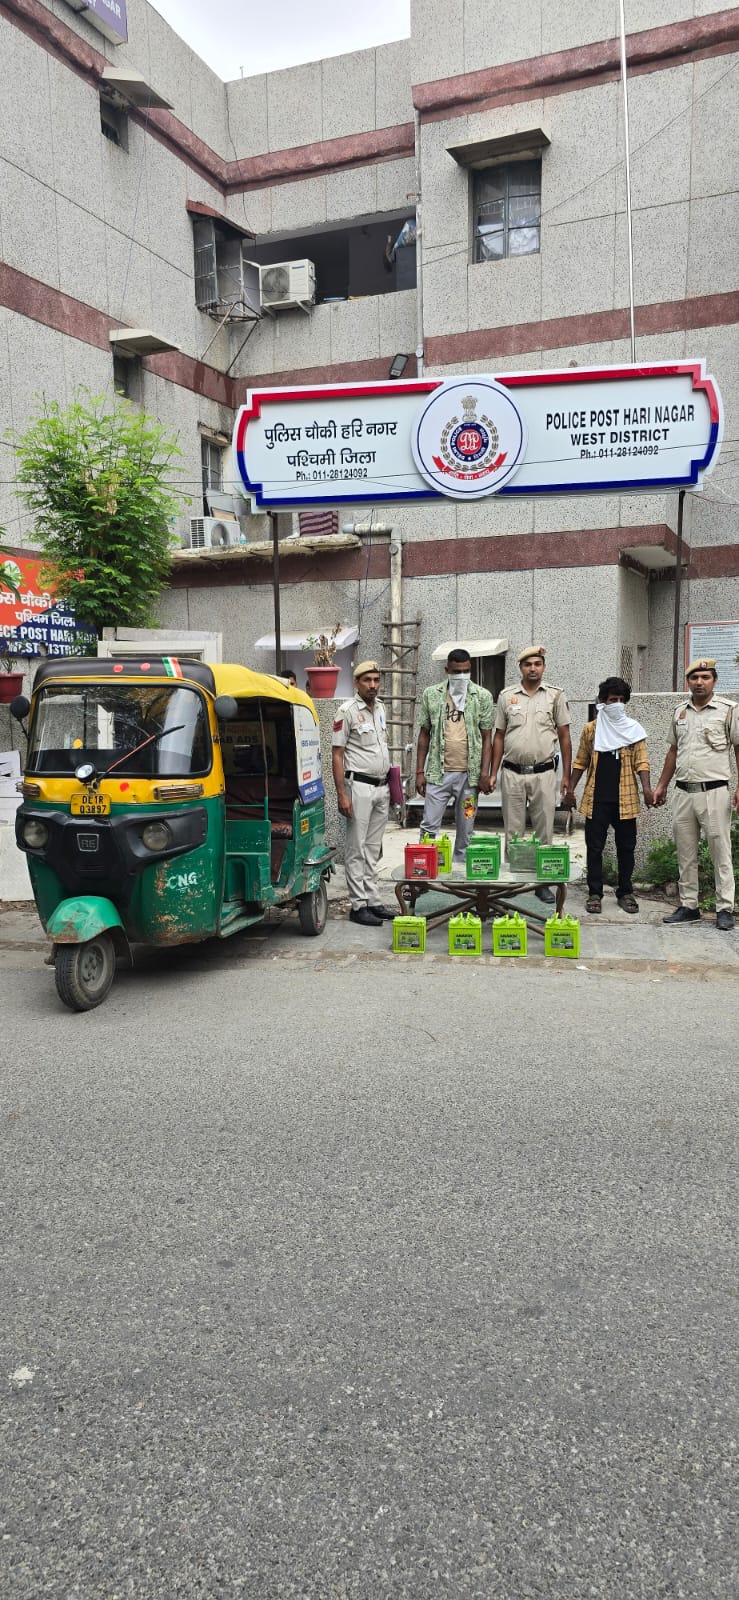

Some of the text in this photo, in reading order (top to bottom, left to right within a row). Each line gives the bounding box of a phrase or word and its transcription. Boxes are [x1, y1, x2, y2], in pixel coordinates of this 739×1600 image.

[546, 404, 695, 430] POLICE POST HARI NAGAR
[264, 418, 398, 450] पुलिस चौकी हरि नगर
[570, 428, 670, 446] WEST DISTRICT
[287, 448, 377, 467] पश्चिमी जिला
[598, 445, 659, 458] 011-28124092
[312, 468, 368, 480] 011-28124092
[20, 626, 48, 641] POST
[79, 804, 107, 814] 03897
[167, 872, 198, 890] CNG
